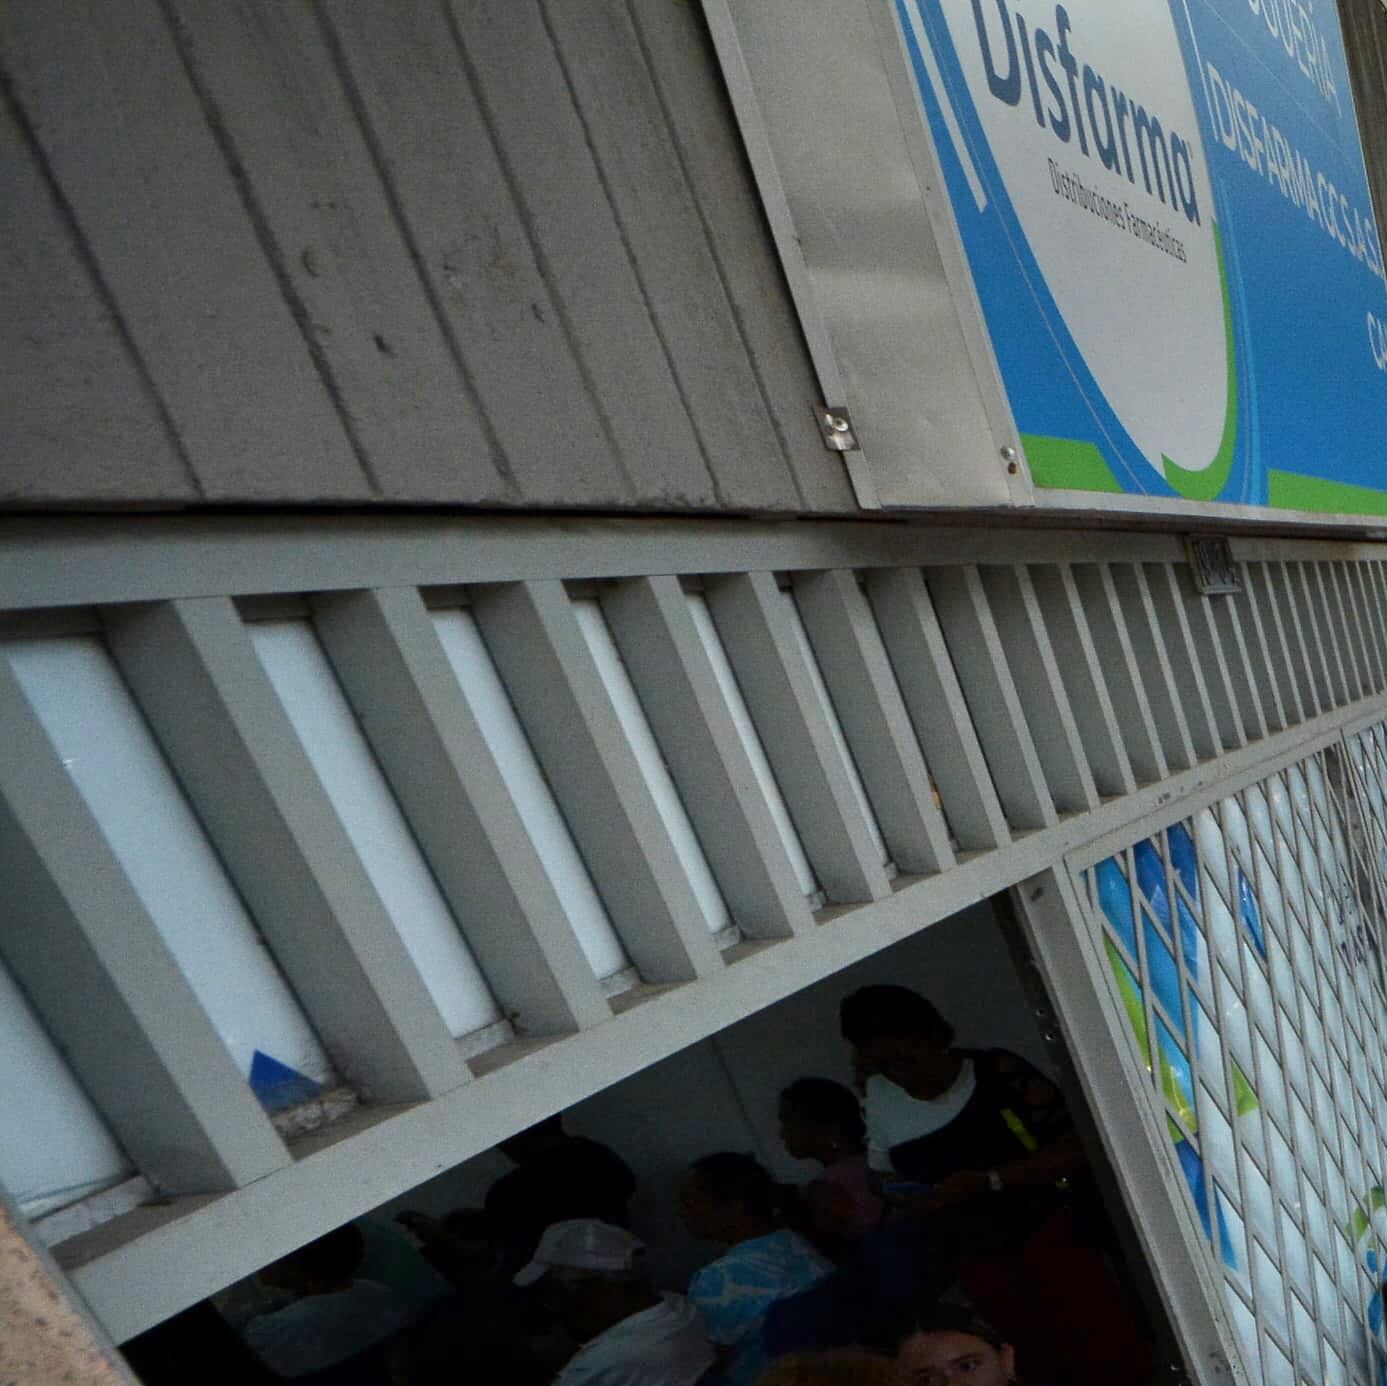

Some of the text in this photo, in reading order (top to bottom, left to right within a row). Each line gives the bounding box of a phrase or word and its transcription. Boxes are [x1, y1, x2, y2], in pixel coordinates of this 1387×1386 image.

[970, 0, 1201, 226] Disfarma
[1206, 61, 1325, 229] DISFARMA
[1047, 157, 1187, 263] Distribuciones Farmacéuticas
